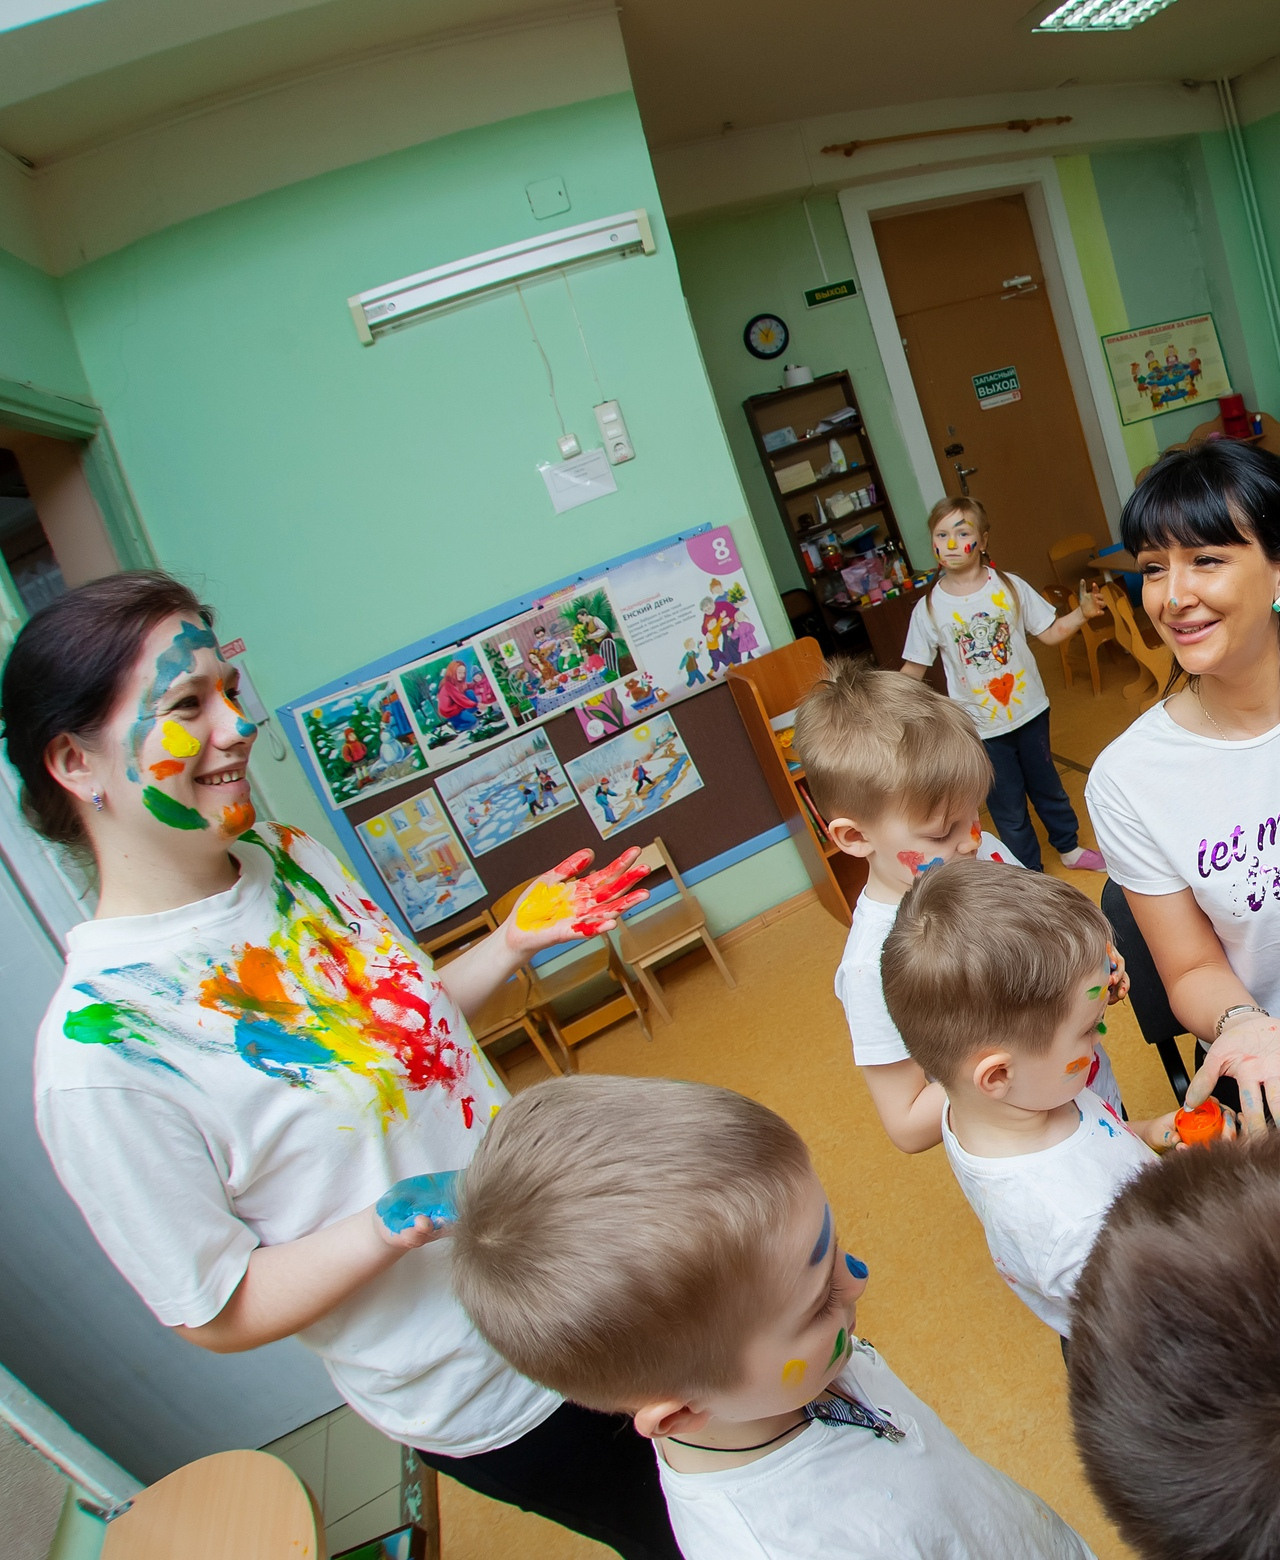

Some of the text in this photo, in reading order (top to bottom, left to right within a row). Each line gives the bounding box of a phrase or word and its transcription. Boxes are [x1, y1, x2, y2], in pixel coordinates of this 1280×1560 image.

[814, 285, 848, 300] ВЫХОД
[1107, 333, 1138, 344] ПРАВИЛА
[974, 369, 1016, 386] ЗАПАСНЫЙ
[977, 378, 1018, 397] ВЫХОД
[711, 537, 730, 560] 8
[654, 596, 674, 610] ДЕНЬ
[1197, 824, 1247, 878] let
